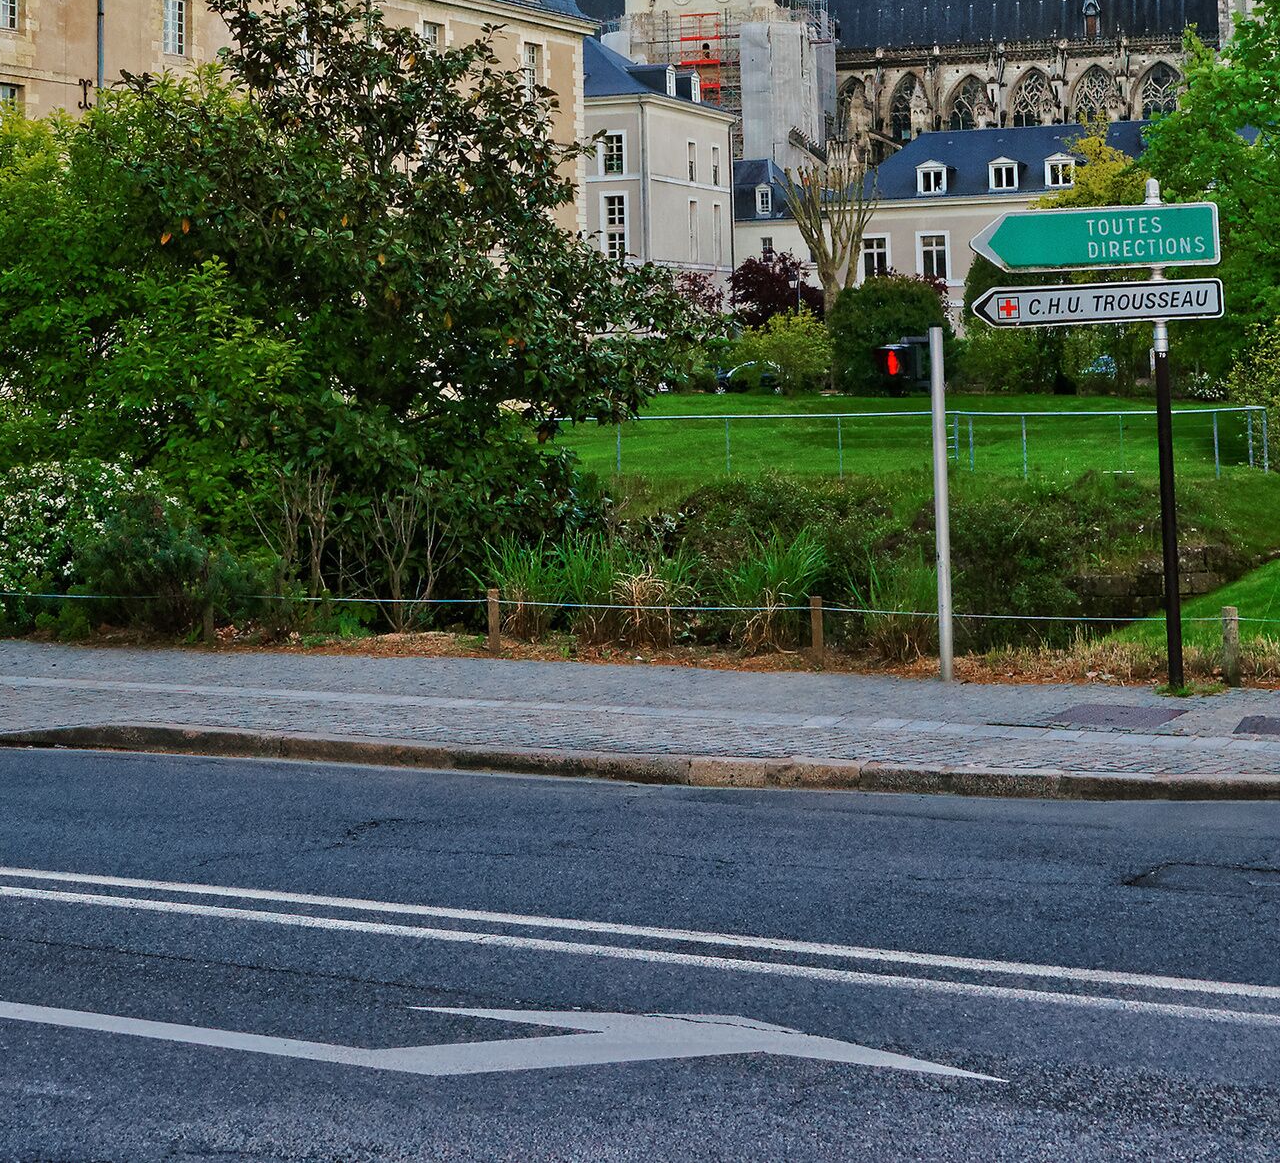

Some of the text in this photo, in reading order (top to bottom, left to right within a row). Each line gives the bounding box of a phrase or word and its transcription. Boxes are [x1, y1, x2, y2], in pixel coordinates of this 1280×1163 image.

[1086, 217, 1162, 236] TOUTES
[1088, 237, 1205, 258] DIRECTIONS
[1028, 289, 1209, 315] C.H.U. TROUSSEAU
